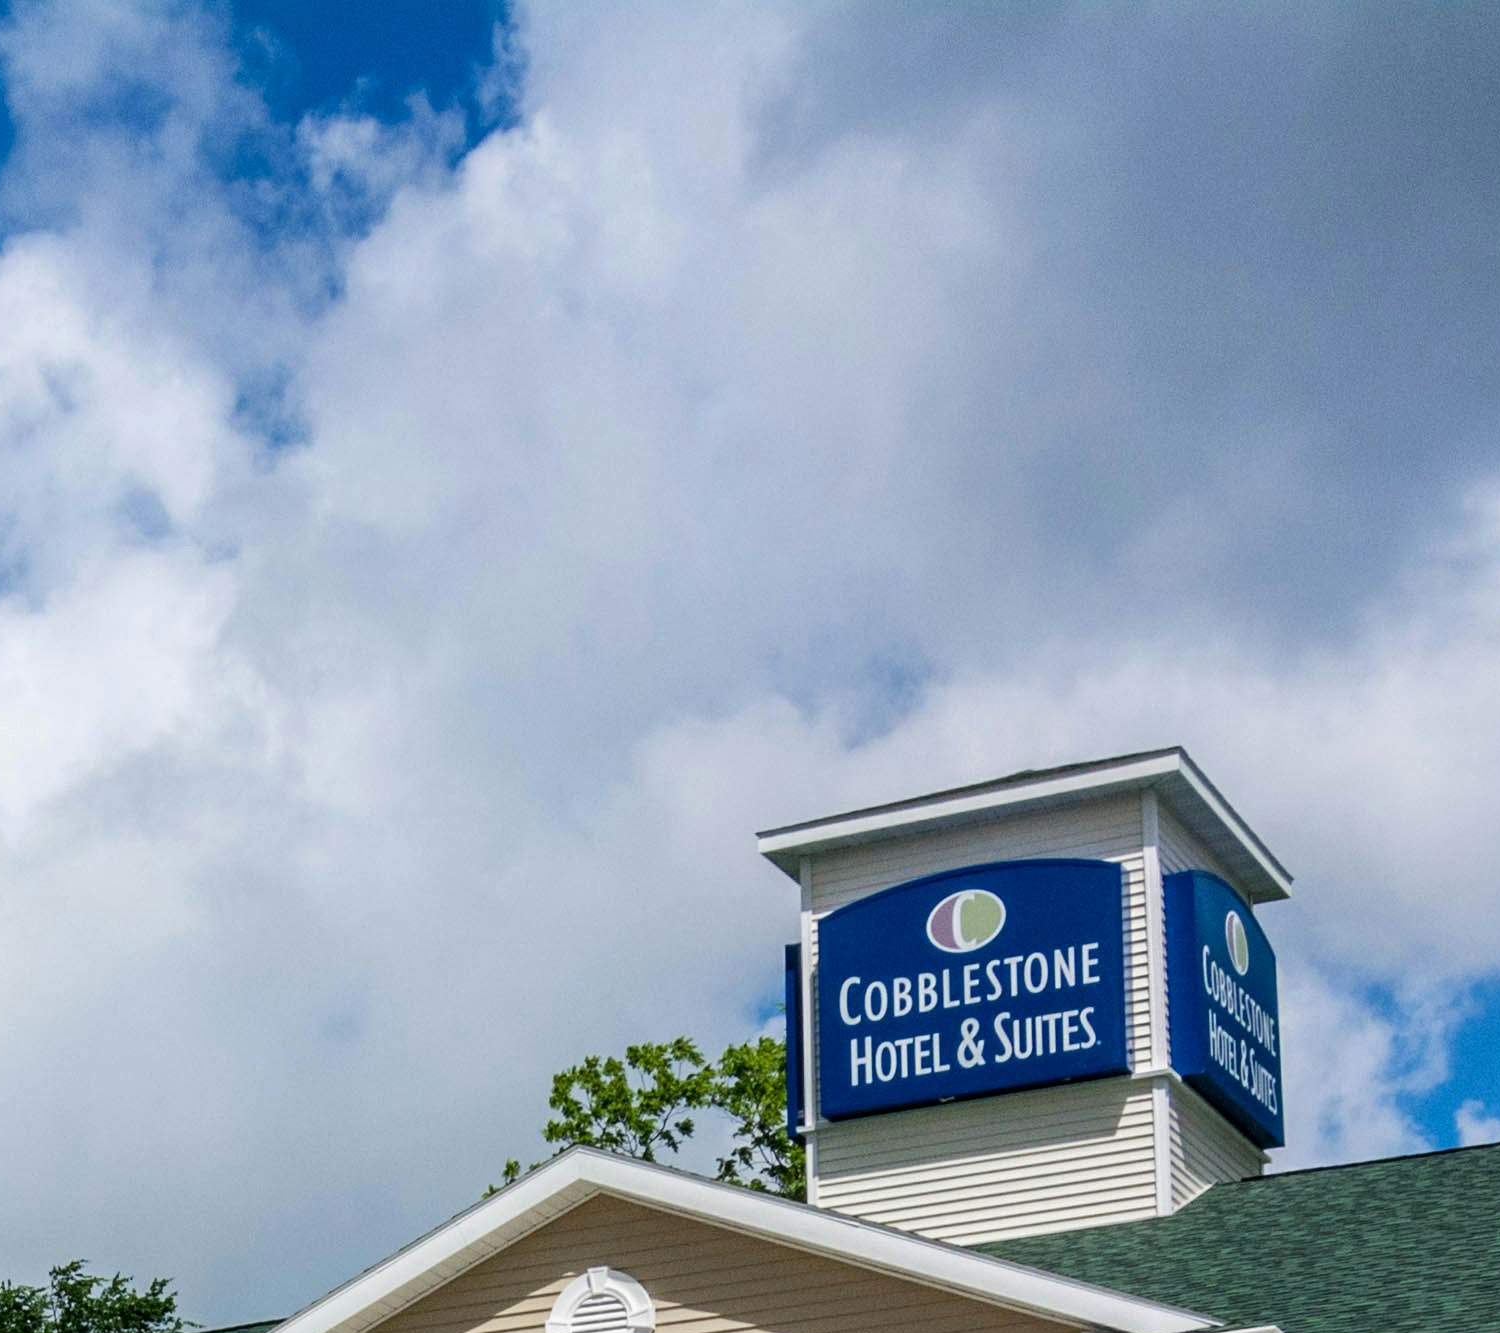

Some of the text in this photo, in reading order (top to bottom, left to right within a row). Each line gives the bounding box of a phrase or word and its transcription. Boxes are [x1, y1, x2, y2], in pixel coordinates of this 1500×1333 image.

[839, 942, 1100, 1026] COBBLESTONE
[1202, 944, 1277, 1057] COBBLESTONE
[850, 1006, 1097, 1087] HOTEL & SUITES
[1208, 1008, 1278, 1115] HOTEL & SUITES
